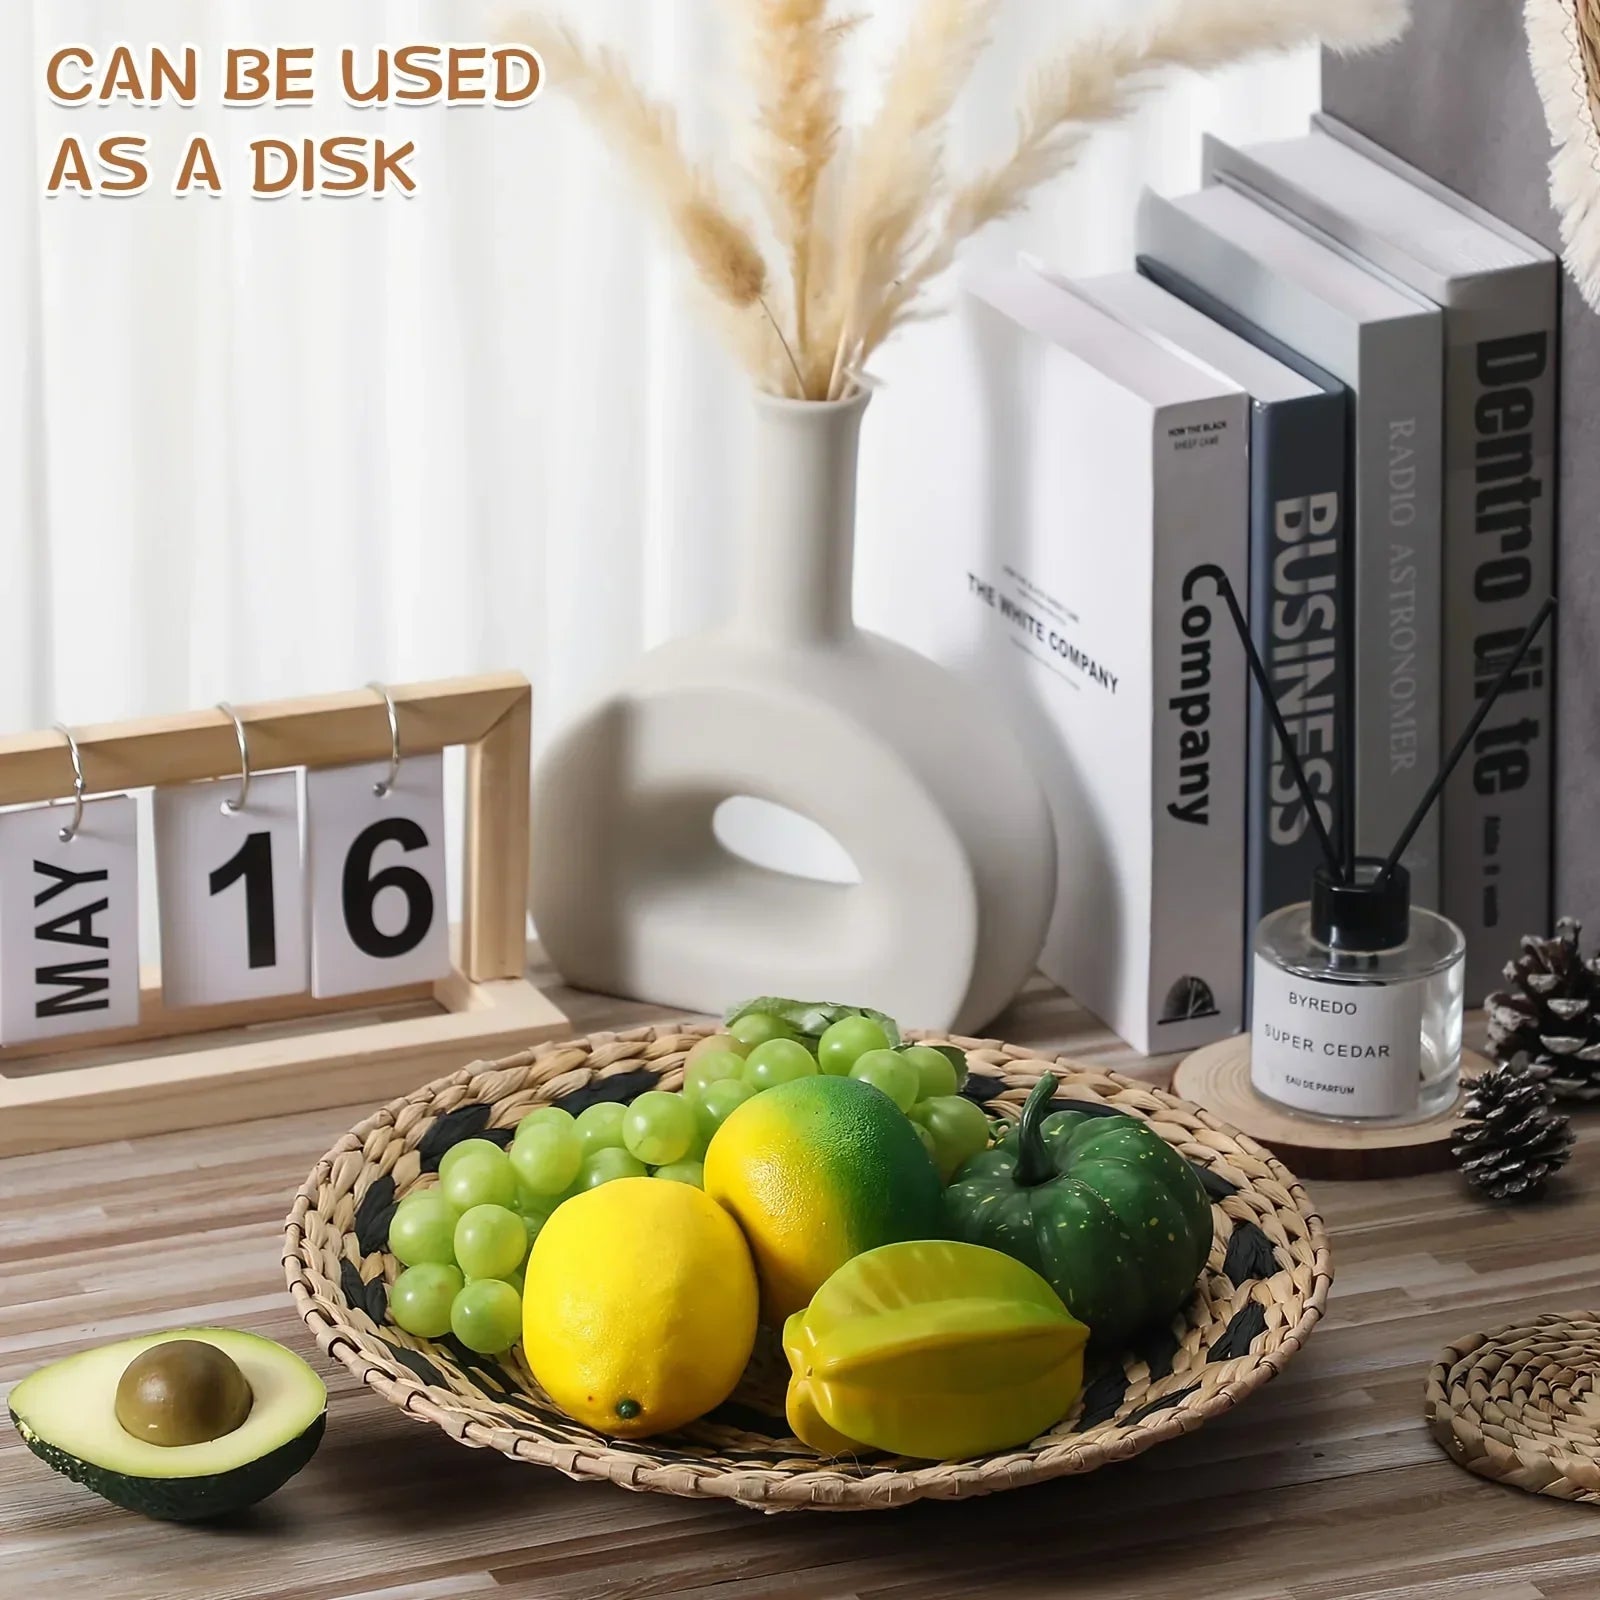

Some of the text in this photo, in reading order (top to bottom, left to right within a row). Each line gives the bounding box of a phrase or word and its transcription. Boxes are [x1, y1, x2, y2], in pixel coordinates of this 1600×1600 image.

[1473, 329, 1547, 603] Dentro
[966, 571, 996, 609] THE
[998, 593, 1045, 642] WHITE
[1048, 630, 1119, 695] COMPANY
[1269, 491, 1338, 846] BUSINESS
[1388, 417, 1418, 777] RADIO ASTRONOMER
[1166, 563, 1227, 827] Company
[1473, 717, 1540, 796] te
[33, 859, 109, 1019] MAY
[208, 818, 434, 969] 1 6
[1264, 1023, 1391, 1059] SUPER CEDAR
[1288, 991, 1358, 1016] BYREDO
[1285, 1075, 1356, 1095] EAU DE PARFUM
